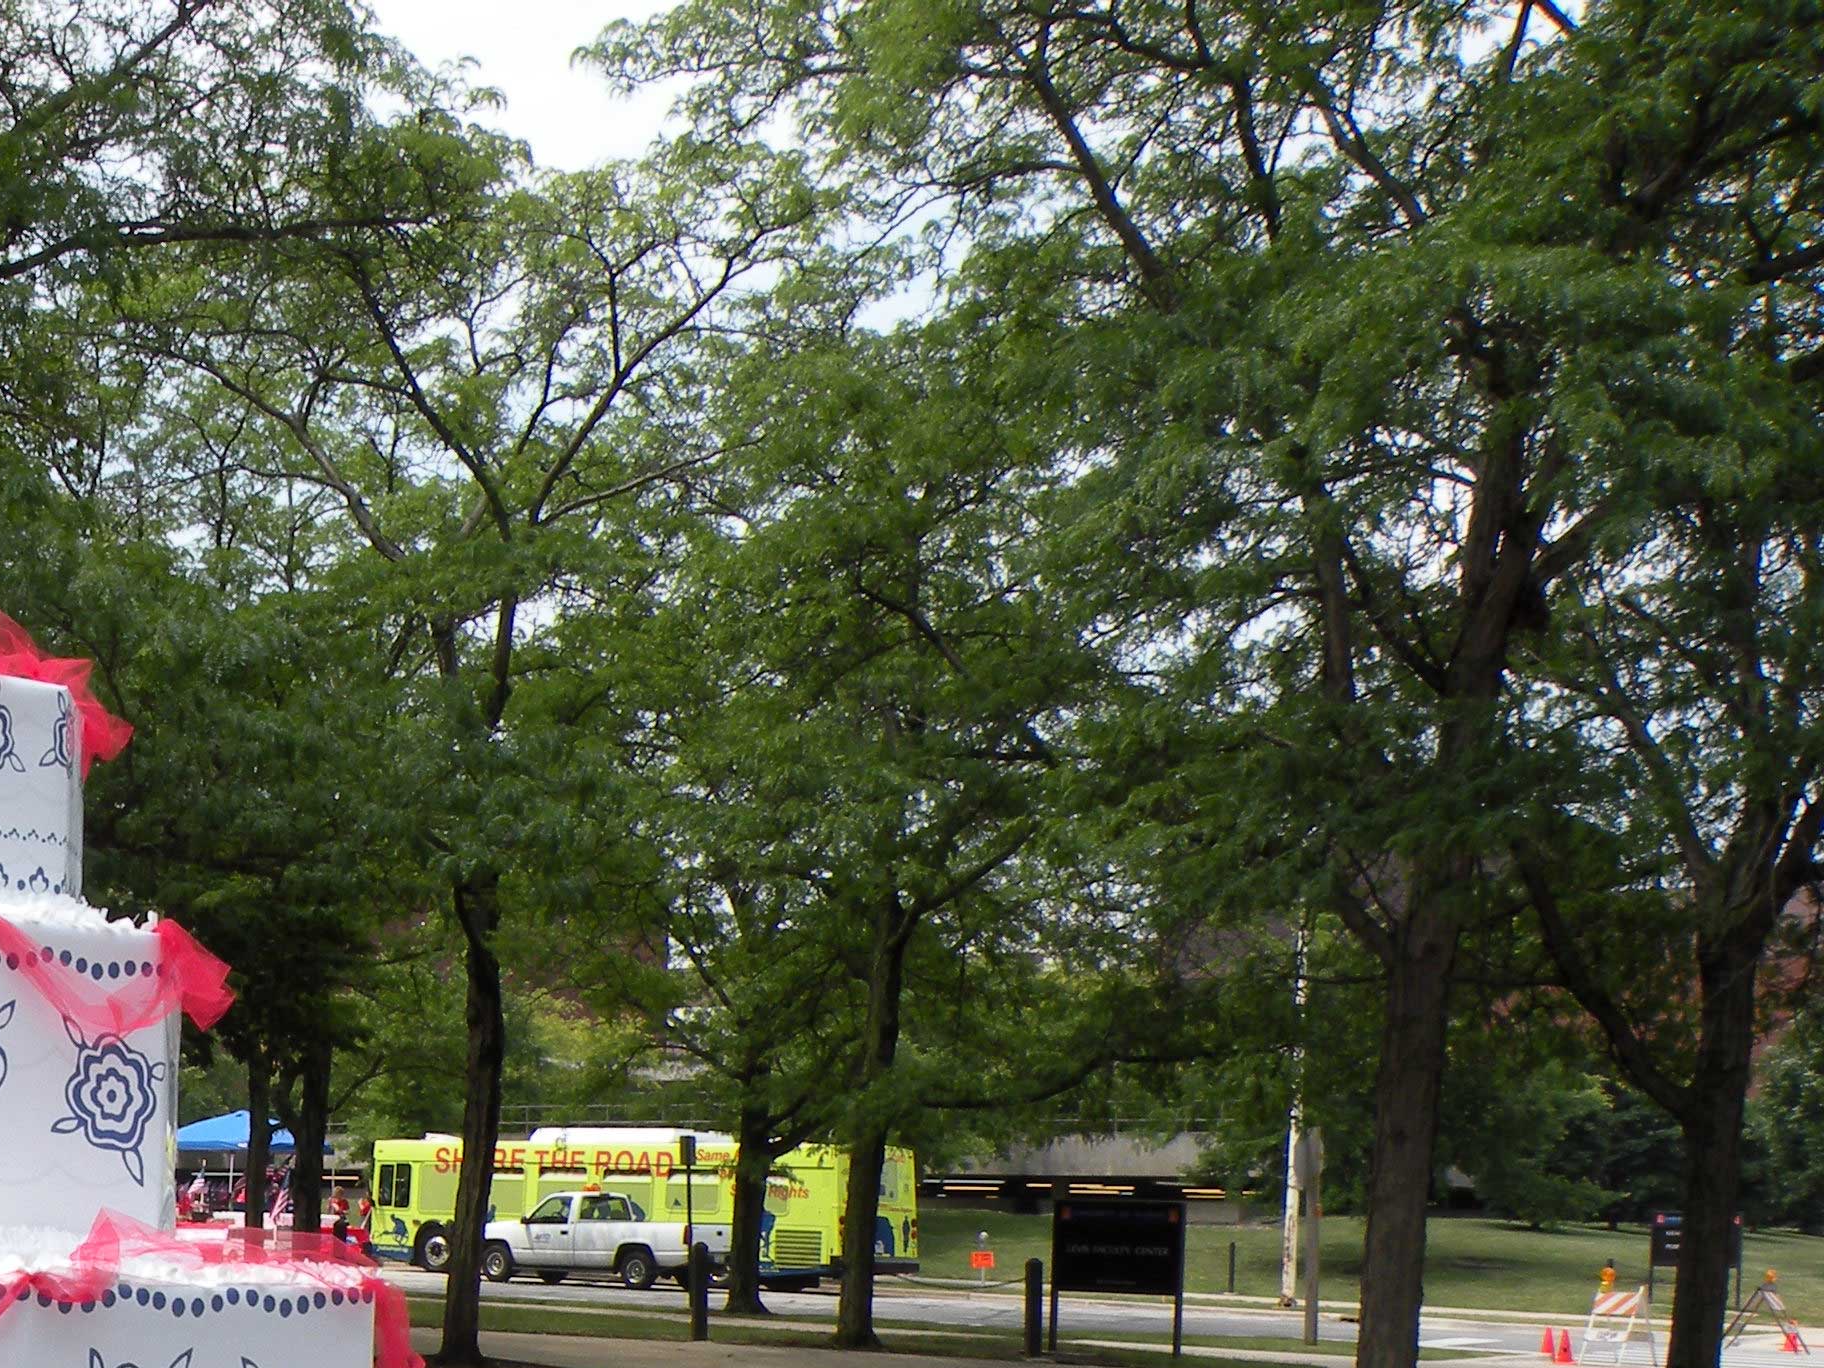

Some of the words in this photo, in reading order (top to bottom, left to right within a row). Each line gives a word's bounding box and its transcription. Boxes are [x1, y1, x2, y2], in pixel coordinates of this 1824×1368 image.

[435, 1147, 525, 1175] SHRE
[534, 1150, 586, 1174] THE
[594, 1150, 674, 1177] ROAD
[695, 1148, 730, 1161] Same
[768, 1182, 809, 1201] Rights
